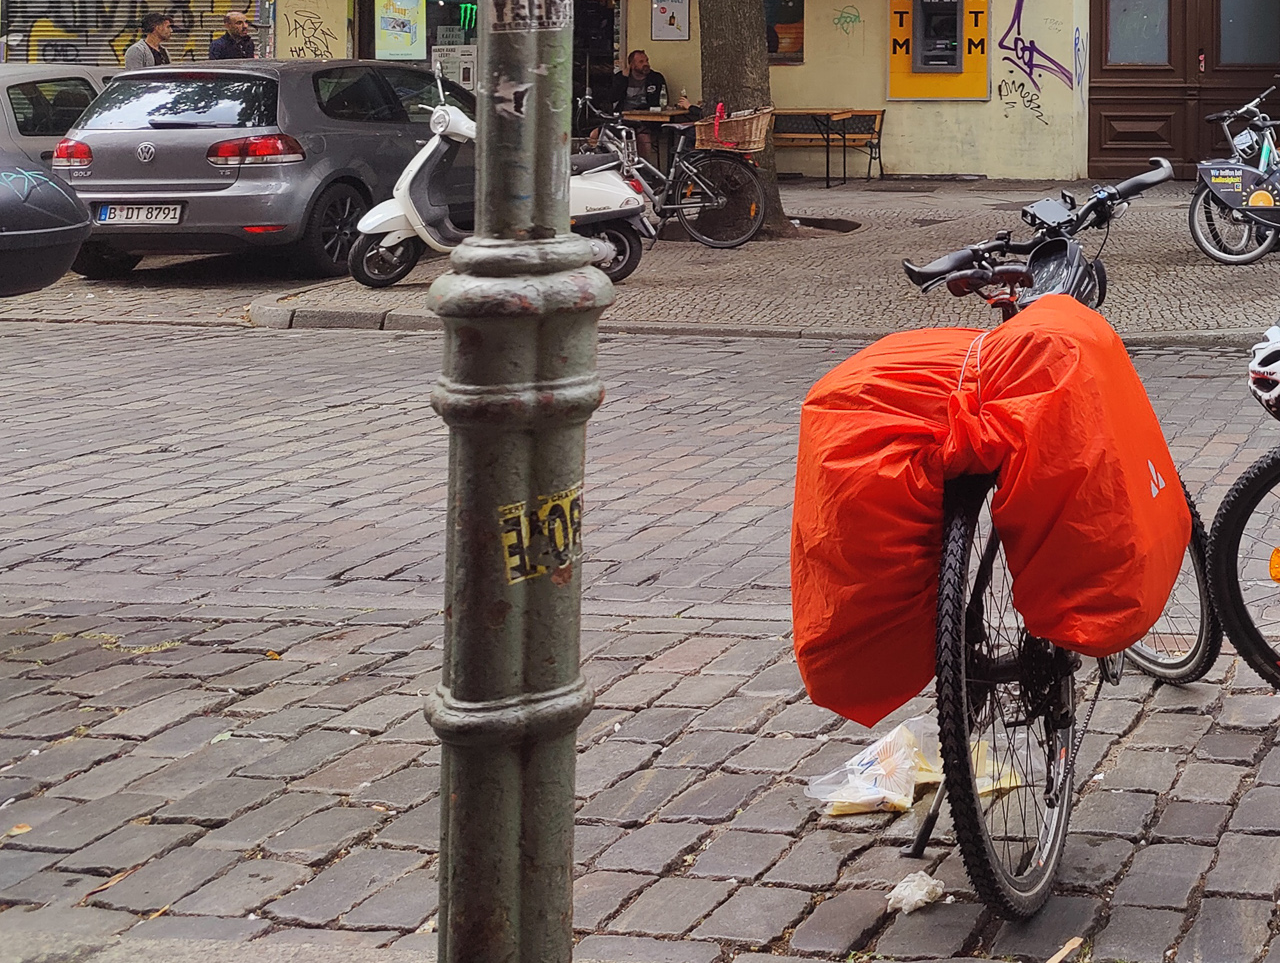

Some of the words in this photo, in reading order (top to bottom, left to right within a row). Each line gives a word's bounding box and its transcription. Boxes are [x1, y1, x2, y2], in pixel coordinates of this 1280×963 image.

[108, 207, 116, 219] B
[125, 207, 143, 219] DT
[146, 206, 178, 219] 8791
